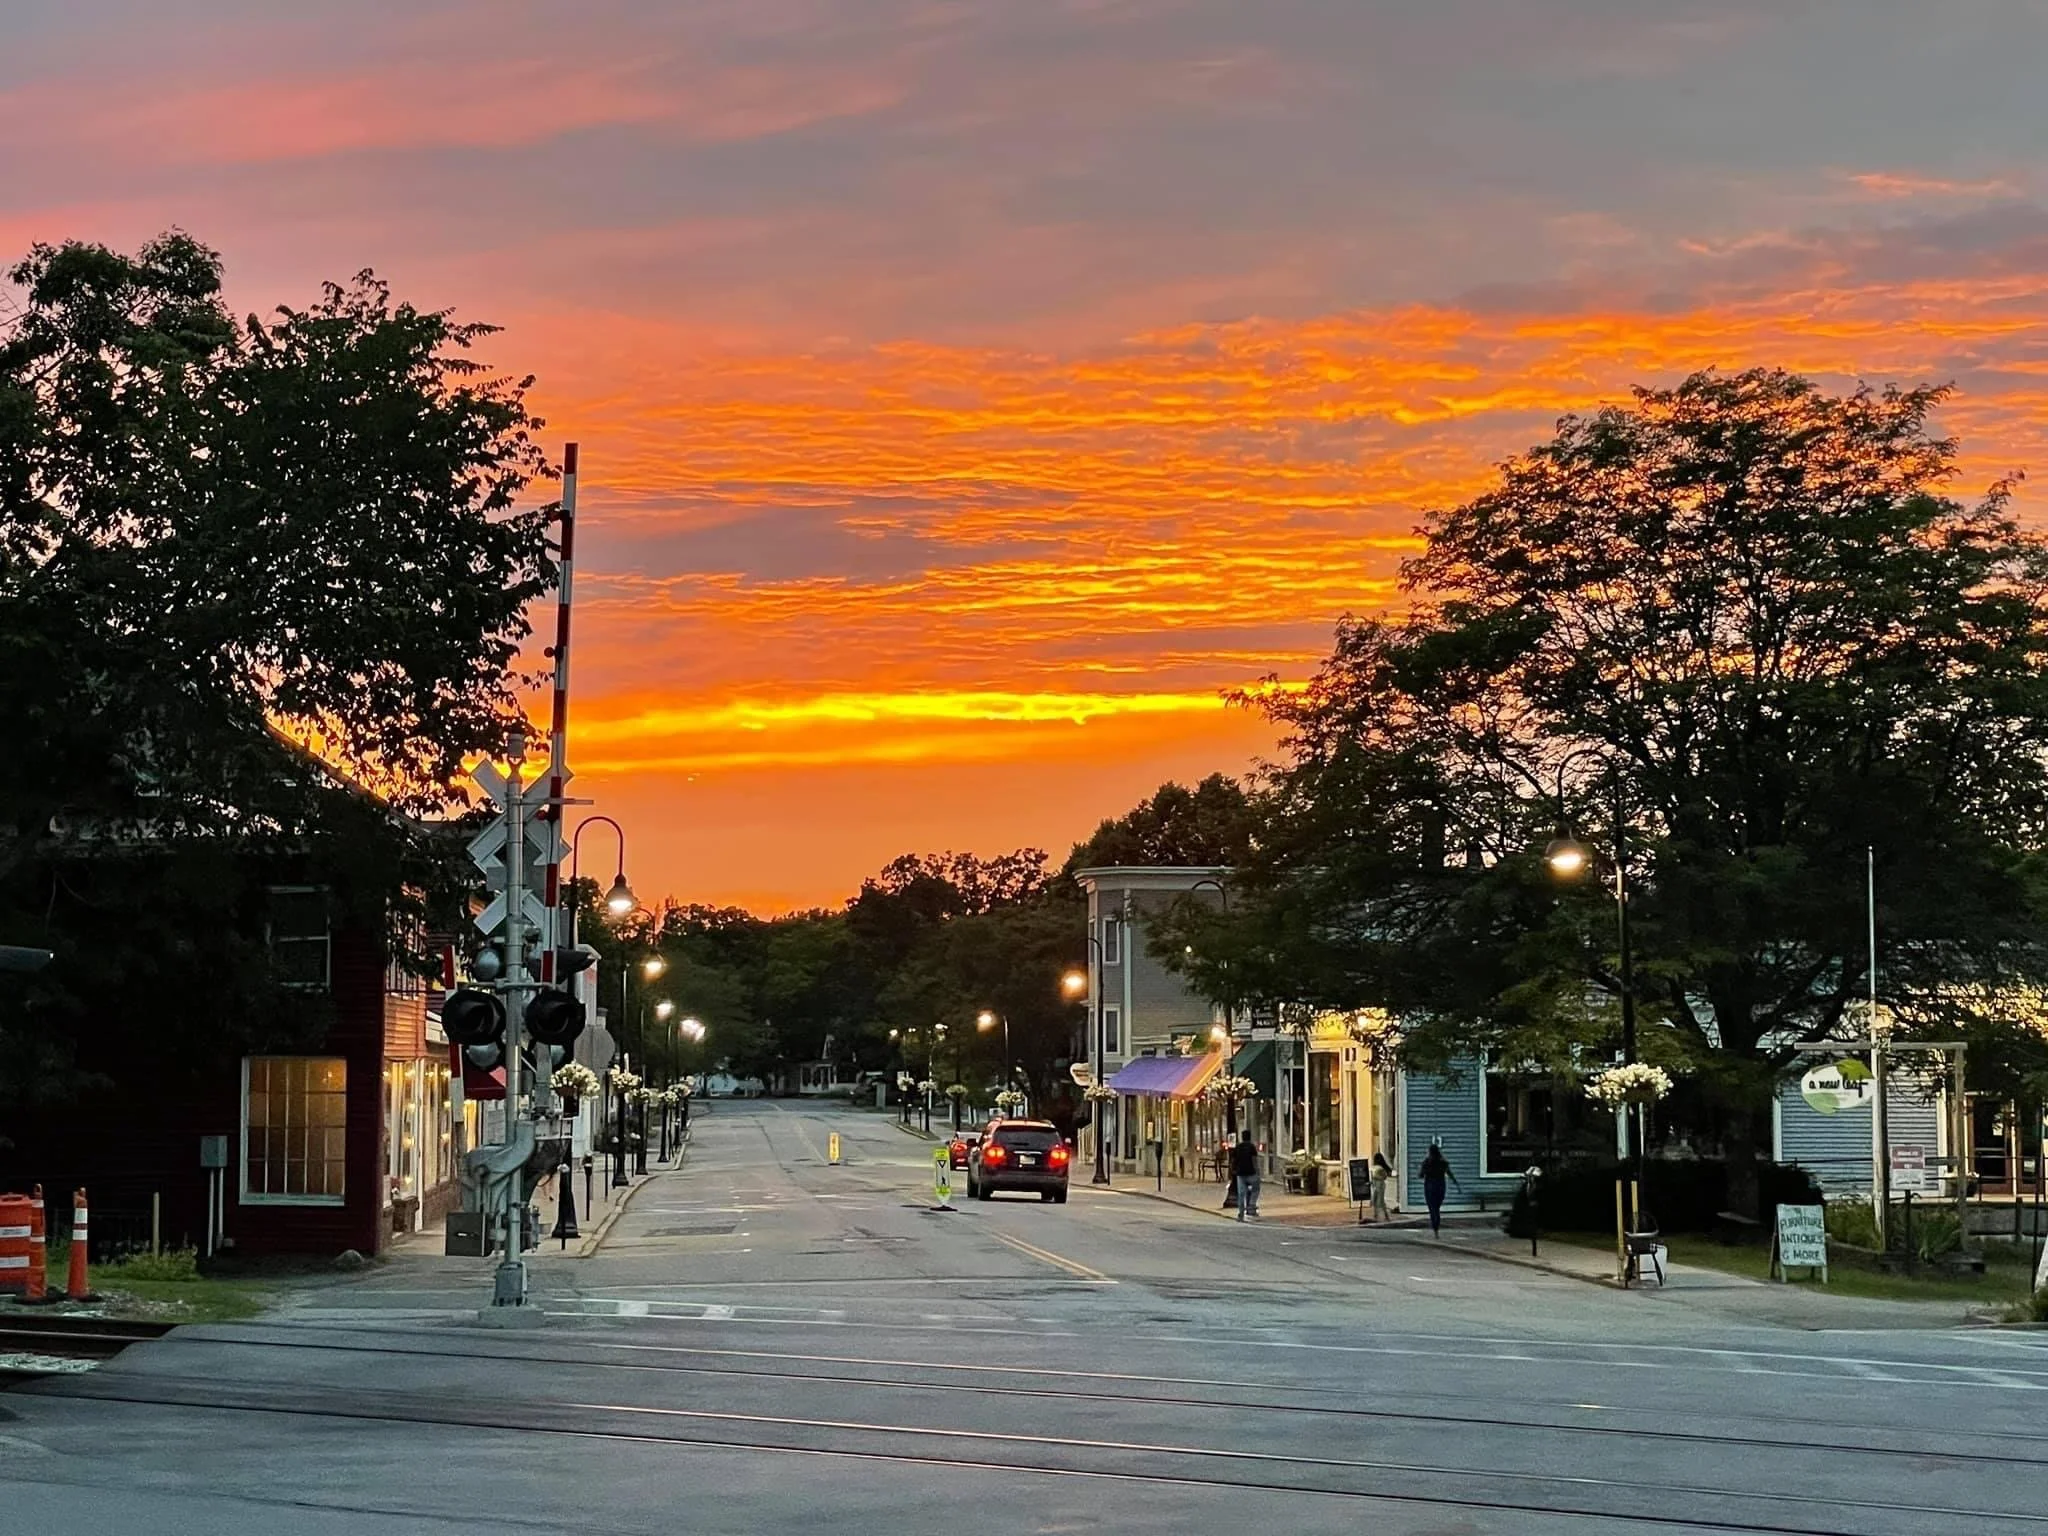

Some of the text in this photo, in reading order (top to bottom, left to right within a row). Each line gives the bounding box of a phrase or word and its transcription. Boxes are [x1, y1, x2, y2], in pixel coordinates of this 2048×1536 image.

[1808, 1080, 1817, 1090] a
[1818, 1079, 1840, 1090] new
[1843, 1072, 1869, 1098] leaf
[1780, 1216, 1824, 1231] FURNITURE
[1780, 1233, 1824, 1245] ANTIQUES
[1793, 1249, 1821, 1261] MORE
